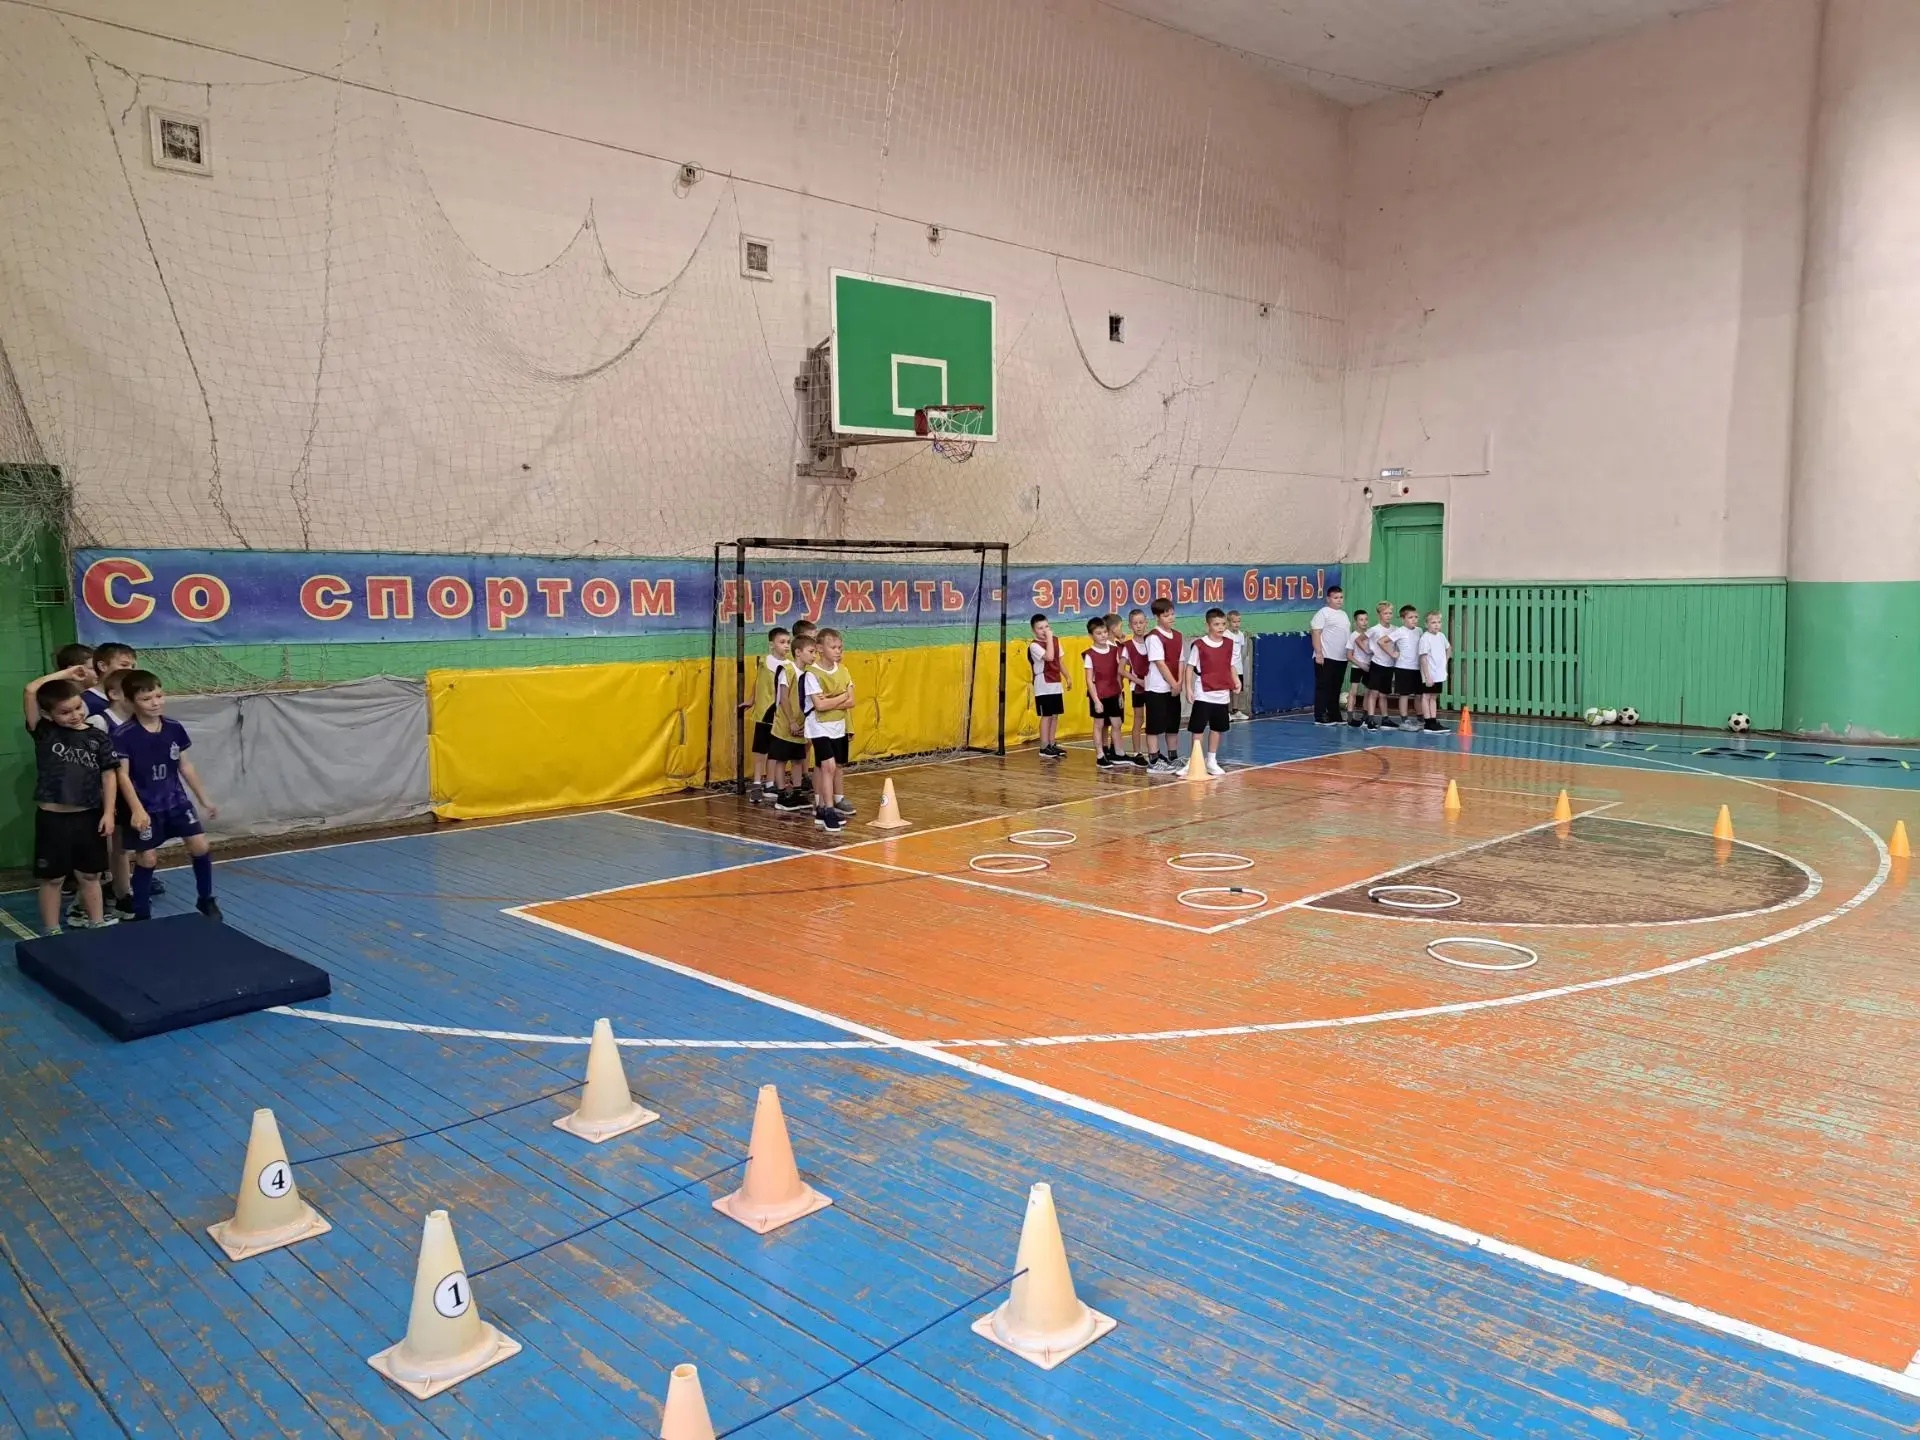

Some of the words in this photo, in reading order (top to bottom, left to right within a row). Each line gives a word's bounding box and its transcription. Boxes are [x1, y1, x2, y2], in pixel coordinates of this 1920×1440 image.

[82, 557, 230, 623] Со
[300, 574, 675, 631] спортом
[719, 579, 964, 624] дружить
[1031, 576, 1224, 614] здоровым
[1243, 568, 1325, 600] быть!
[152, 763, 166, 780] 10
[271, 1168, 285, 1190] 4
[447, 1281, 464, 1308] 1
